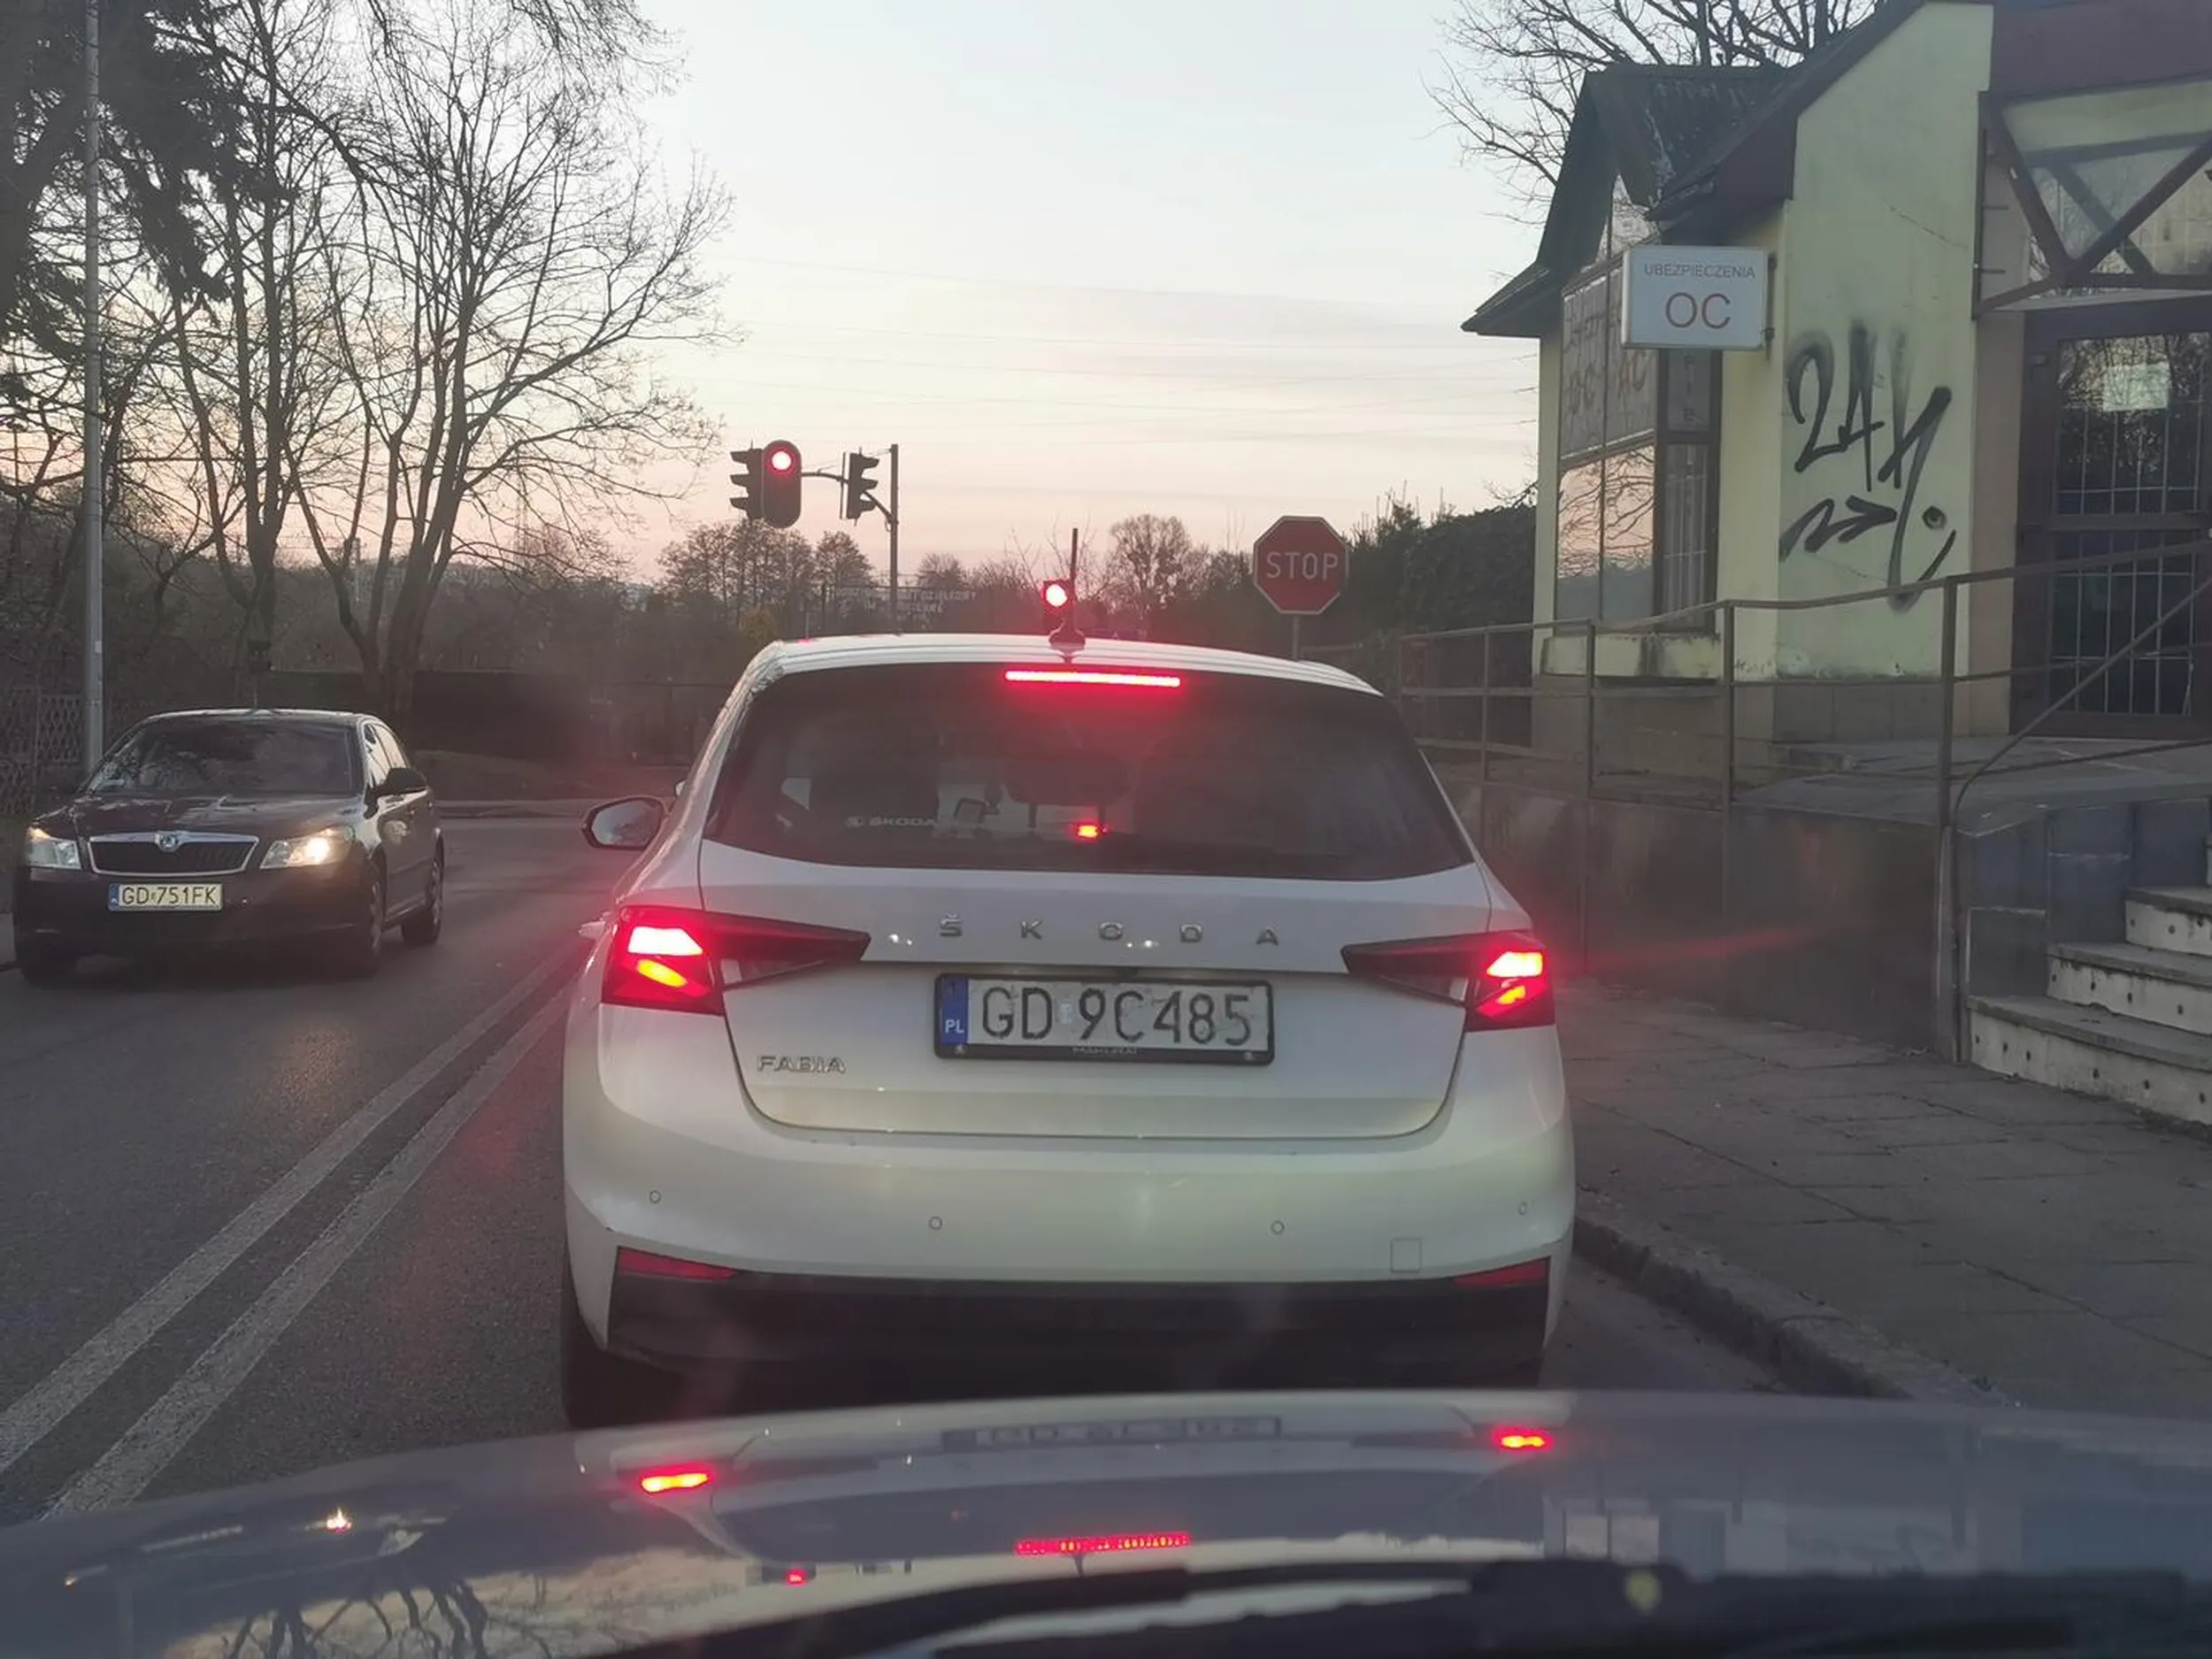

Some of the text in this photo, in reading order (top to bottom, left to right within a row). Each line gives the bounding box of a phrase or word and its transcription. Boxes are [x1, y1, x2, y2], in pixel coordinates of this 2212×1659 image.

[1643, 264, 1756, 279] UBEZPIECZENIA
[1664, 291, 1732, 330] OC
[1266, 551, 1339, 580] STOP
[122, 887, 217, 904] GD 751FK
[939, 911, 1279, 946] ŠKODA
[945, 987, 1251, 1047] PL GD 9C485
[757, 1056, 847, 1074] FABIA
